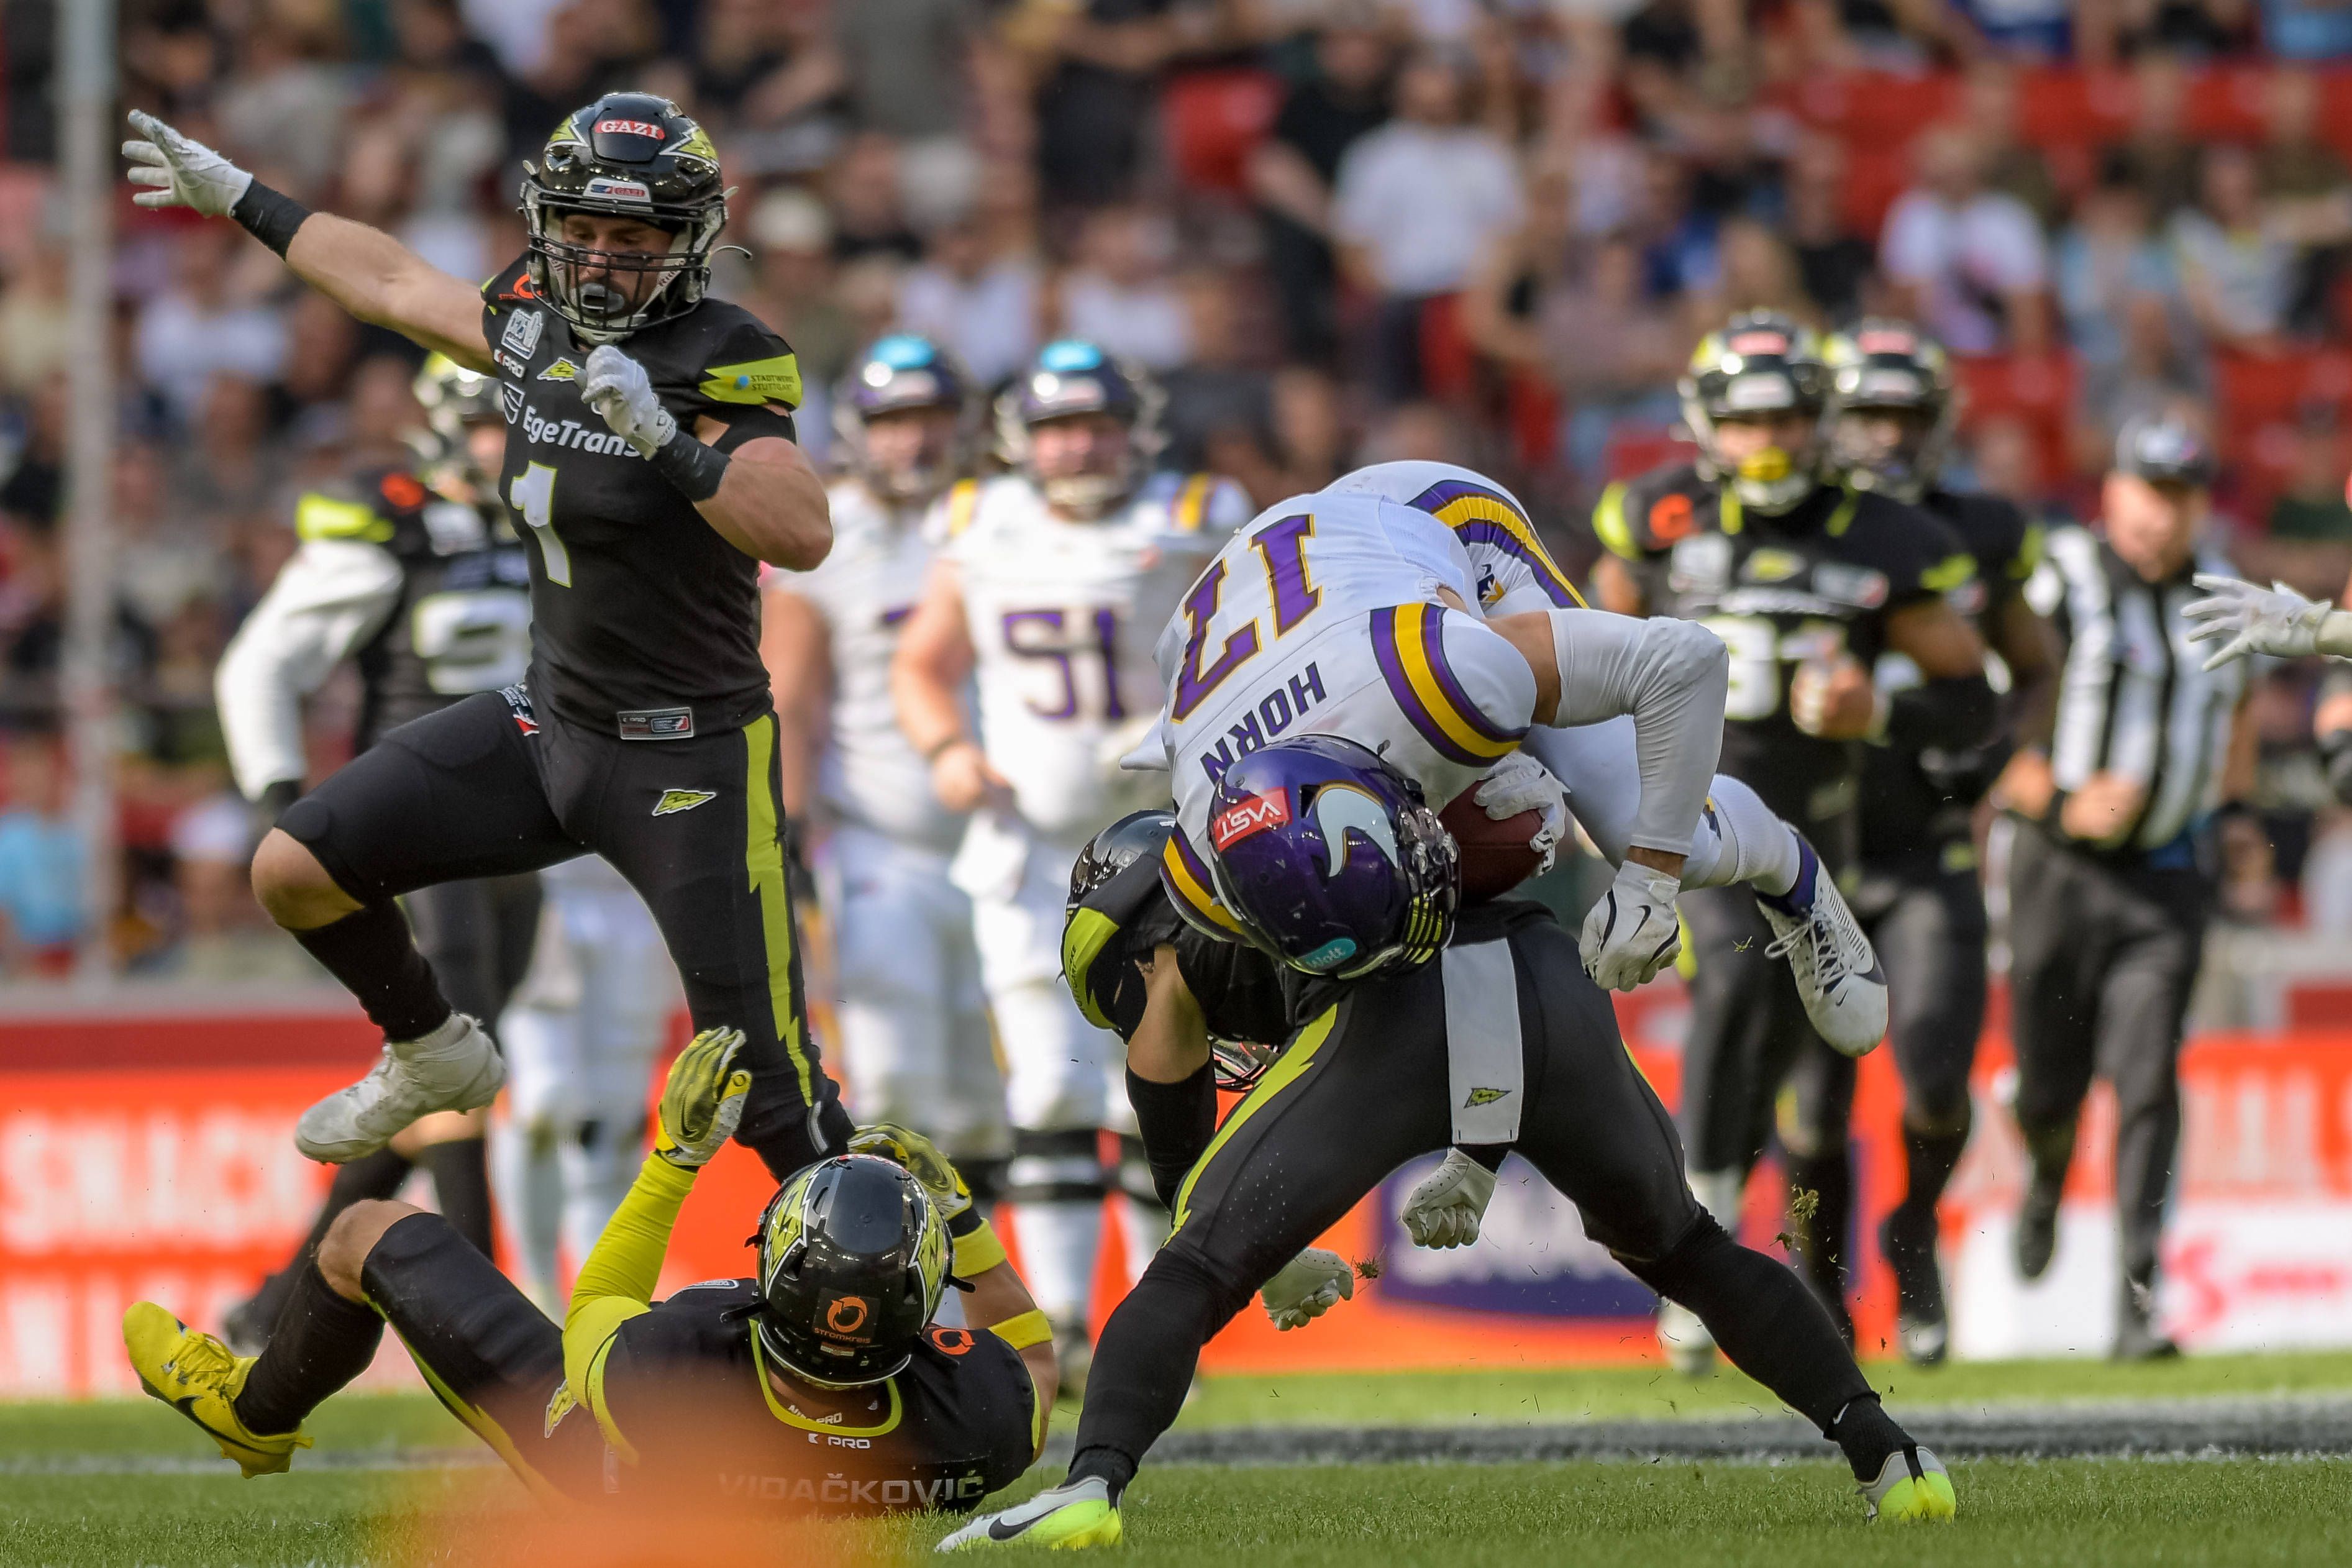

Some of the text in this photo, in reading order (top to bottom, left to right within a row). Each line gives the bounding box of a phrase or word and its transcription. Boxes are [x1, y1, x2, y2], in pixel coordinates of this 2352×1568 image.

[601, 121, 659, 139] GAZI
[509, 460, 572, 588] 1
[1001, 608, 1124, 721] 51
[1172, 513, 1322, 724] 17
[1200, 661, 1327, 788] HORN
[718, 1469, 985, 1504] VIDAČKOVIĆ
